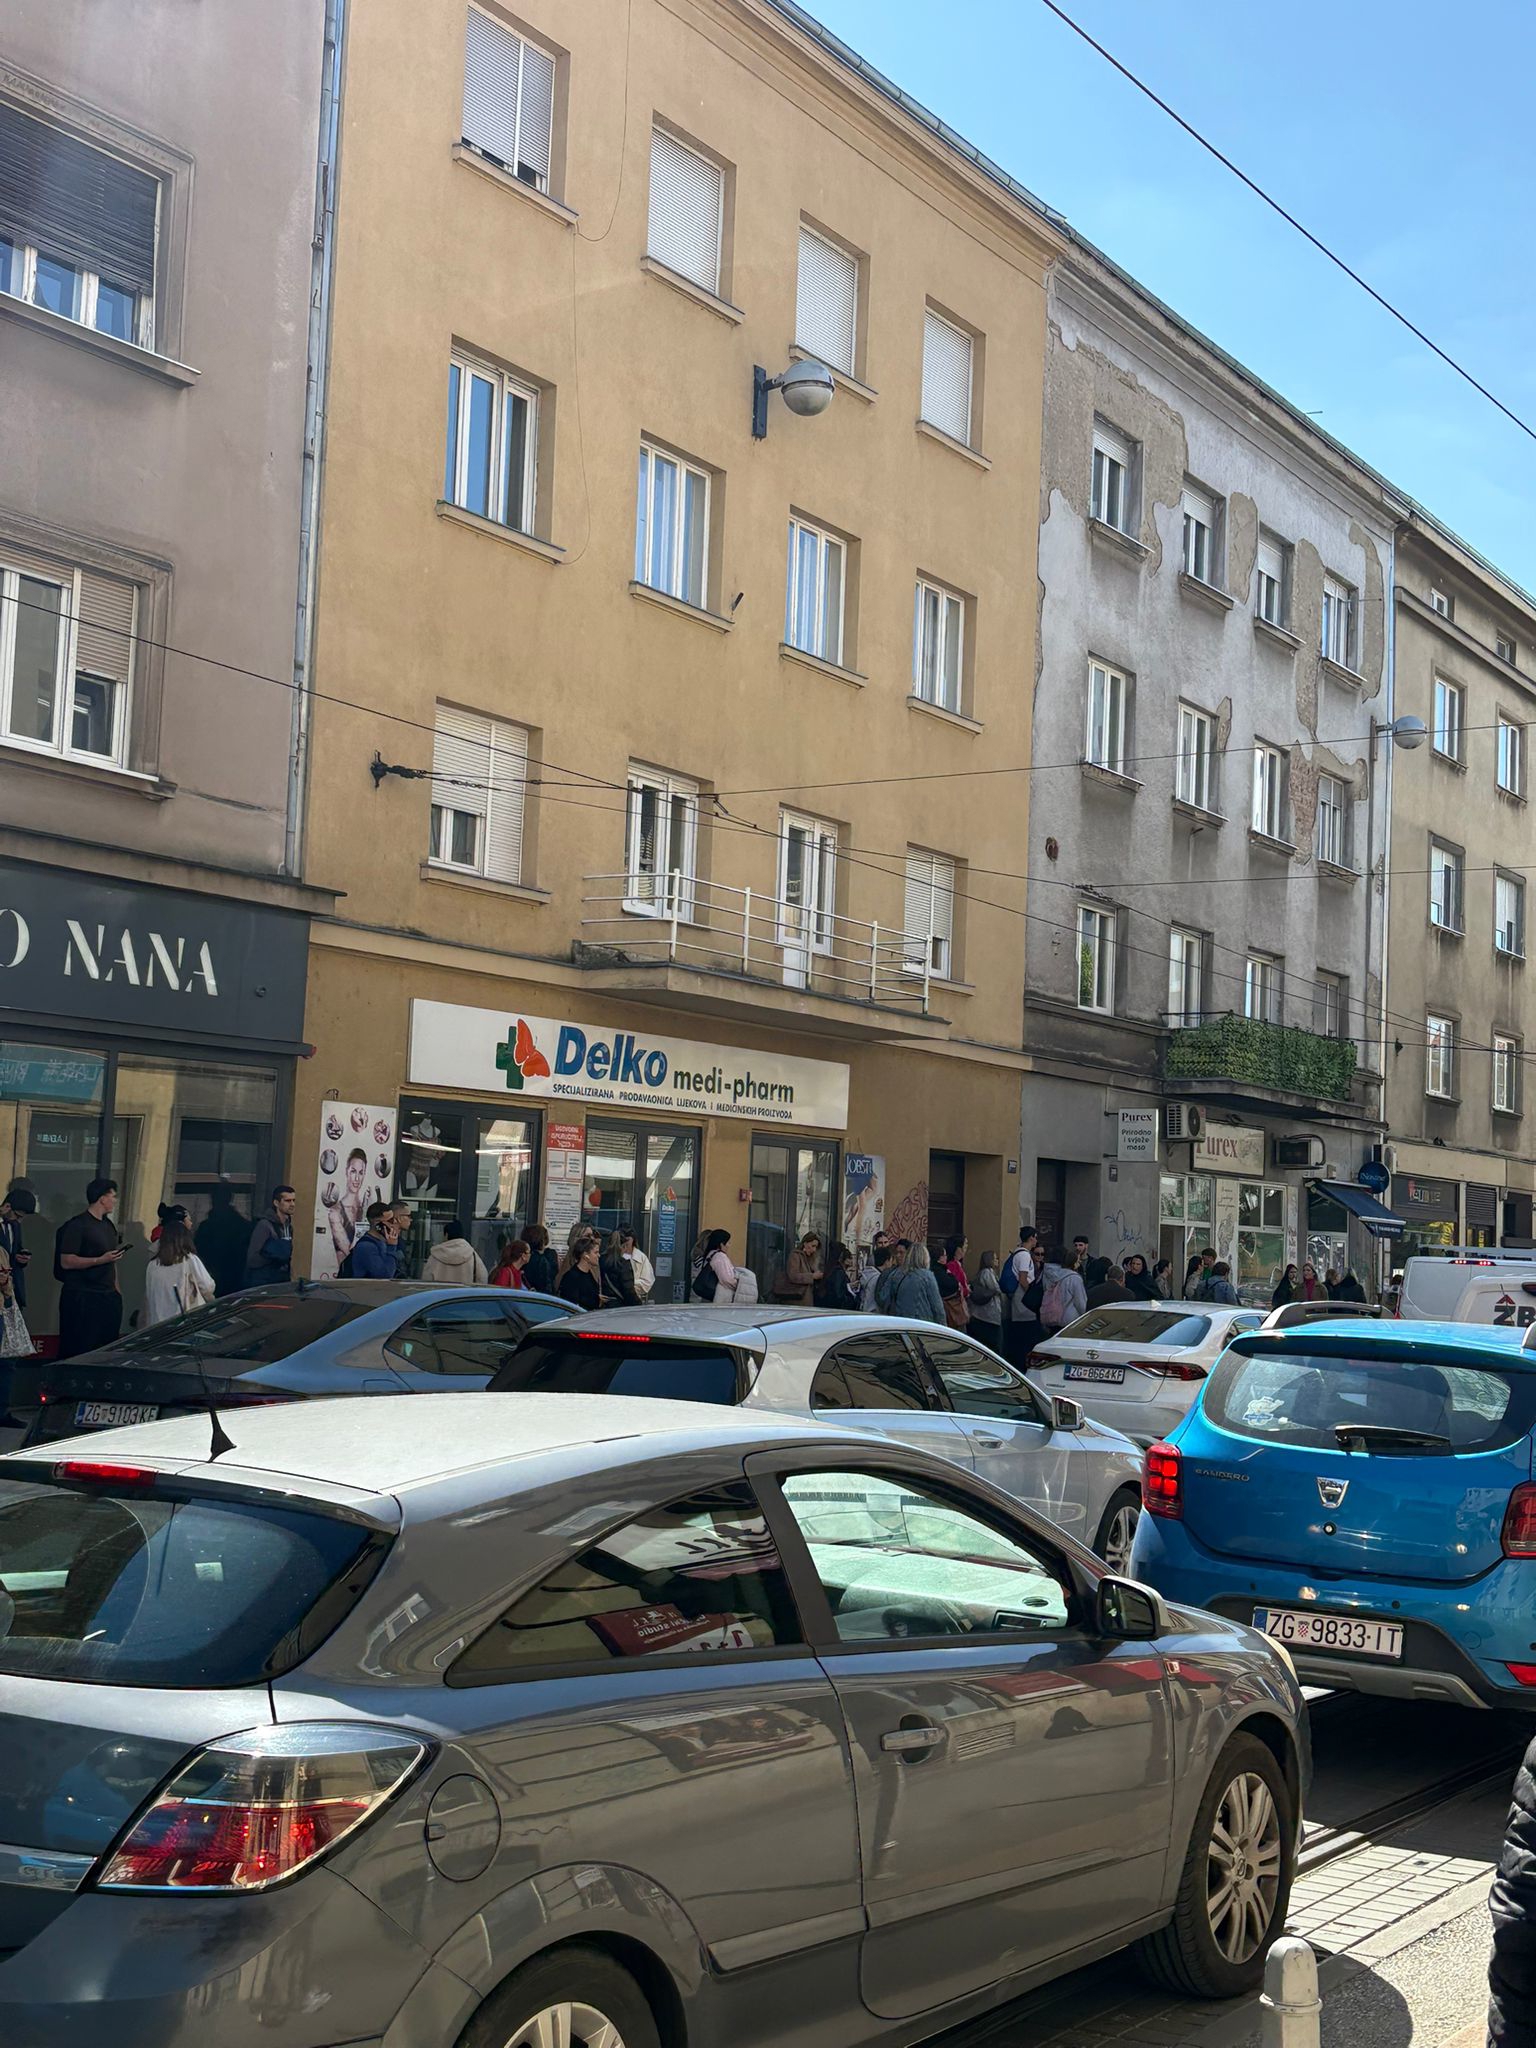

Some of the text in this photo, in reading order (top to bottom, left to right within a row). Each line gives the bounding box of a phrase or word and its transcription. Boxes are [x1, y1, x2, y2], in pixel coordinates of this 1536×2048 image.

[63, 919, 219, 996] NANA
[554, 1025, 794, 1104] Delko medi-pharm
[553, 1083, 614, 1099] SPECIJALIZIRANA
[619, 1091, 673, 1106] PRODAVAONICA
[677, 1097, 707, 1110] LIJEKOVA
[716, 1103, 757, 1115] MEDICINSKIH
[757, 1107, 793, 1119] PROIZVODA
[1121, 1112, 1153, 1122] Purex
[1071, 1366, 1082, 1377] ZG
[84, 1404, 101, 1422] ZG
[1268, 1613, 1295, 1639] ZG
